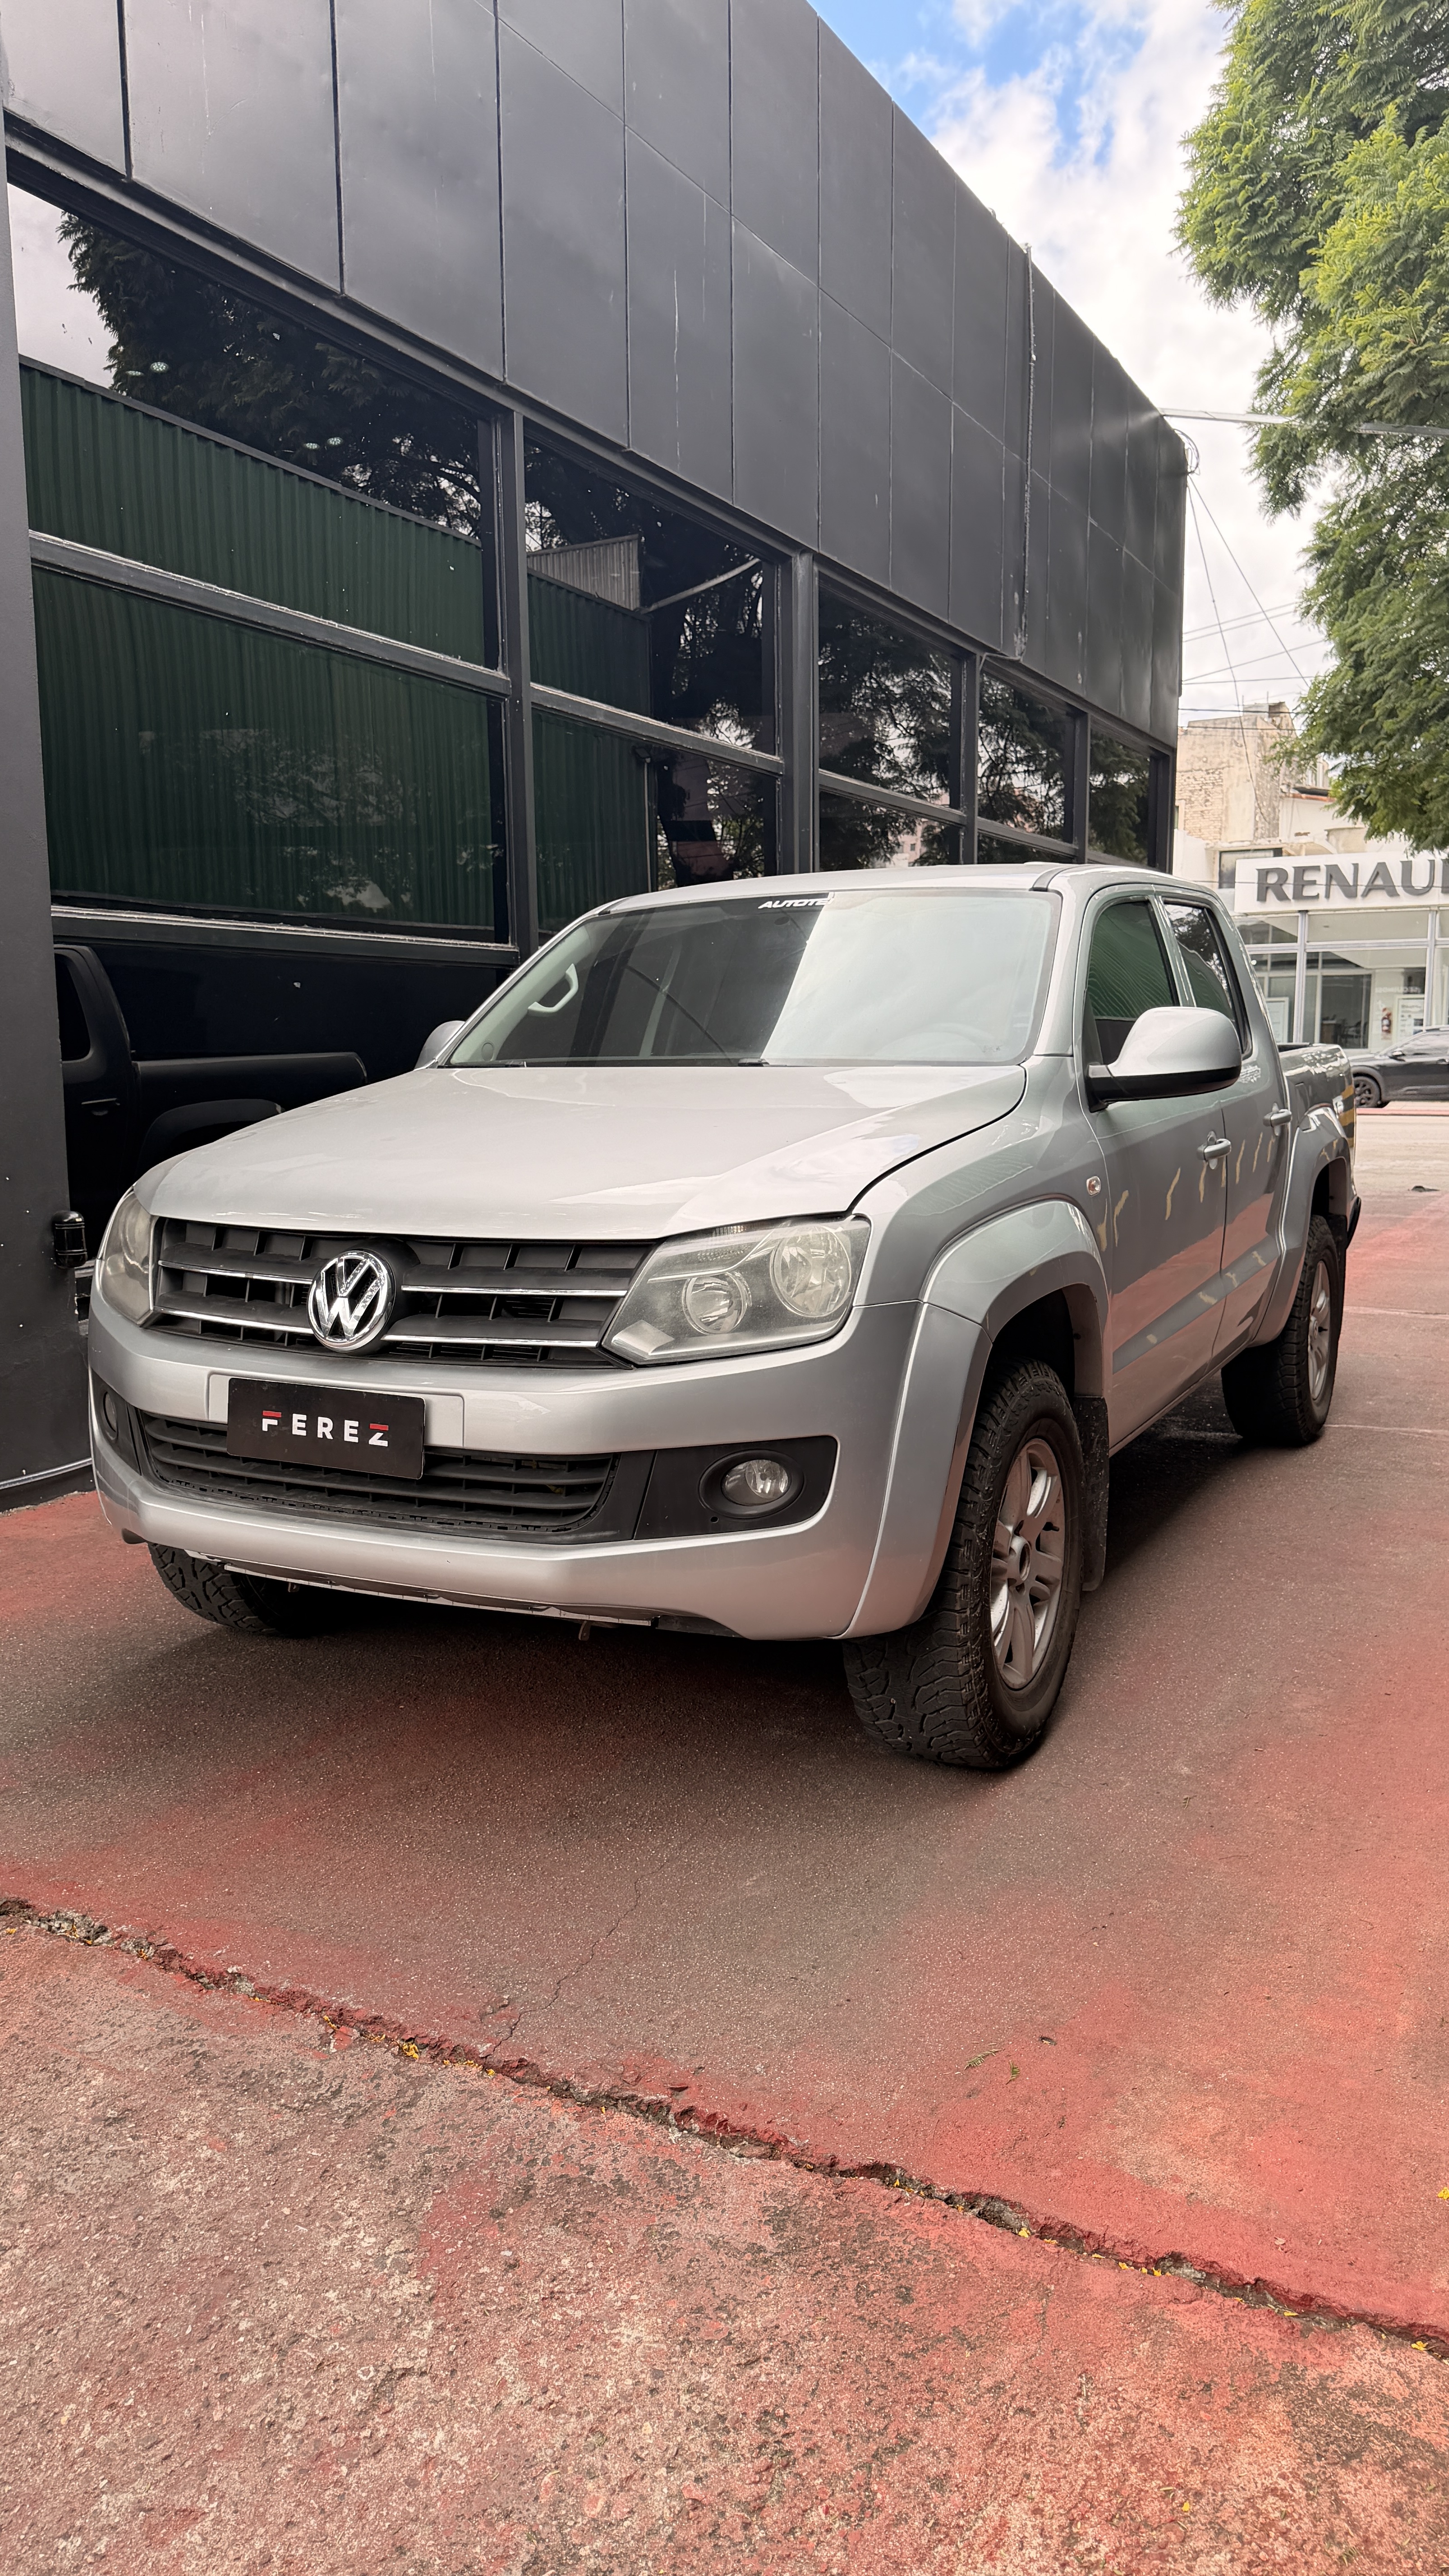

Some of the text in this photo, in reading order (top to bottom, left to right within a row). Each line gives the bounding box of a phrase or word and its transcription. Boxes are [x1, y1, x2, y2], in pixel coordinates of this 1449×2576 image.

[1256, 859, 1449, 902] RENAU
[311, 1253, 391, 1346] VW
[262, 1410, 389, 1447] FEREZ
